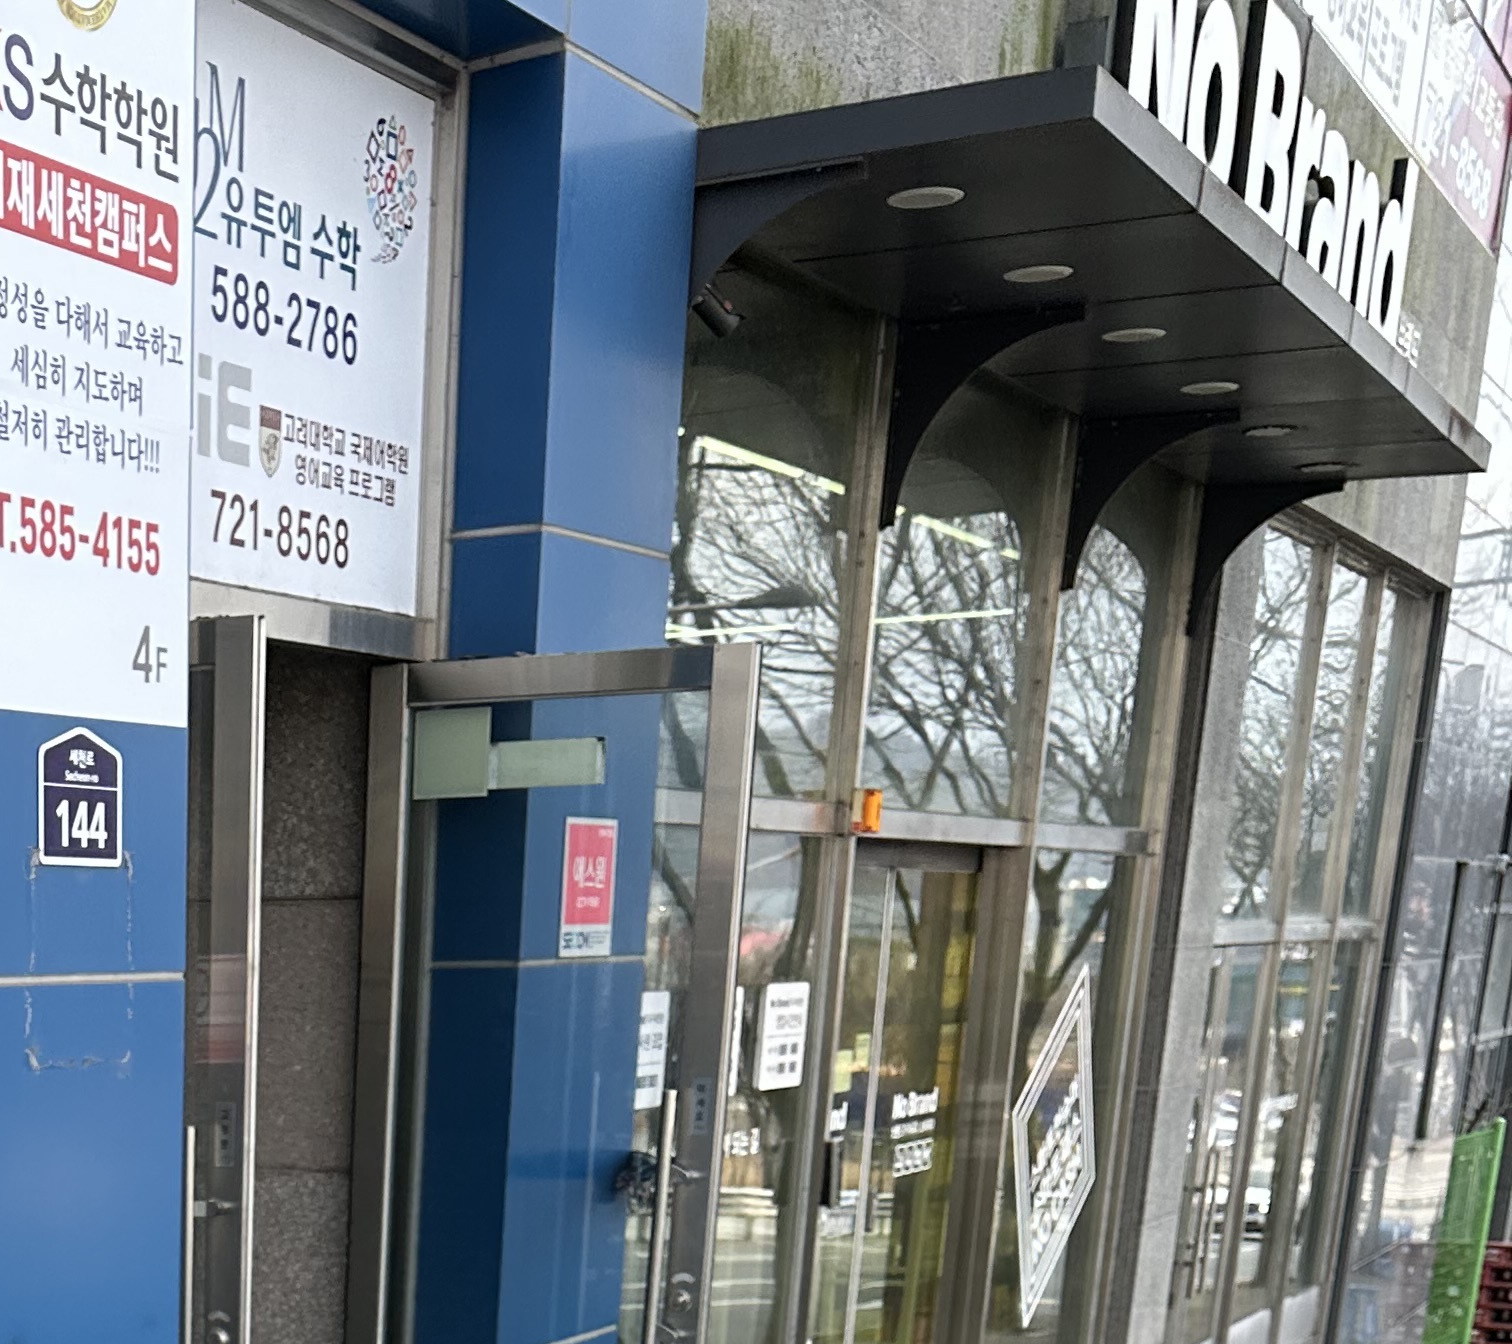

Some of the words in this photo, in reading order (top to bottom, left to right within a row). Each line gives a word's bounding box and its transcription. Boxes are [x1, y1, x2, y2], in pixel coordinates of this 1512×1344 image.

[1244, 0, 1419, 353] Brand
[221, 193, 302, 271] 유투엠
[312, 216, 361, 291] 수학
[56, 296, 110, 350] 다해서
[115, 318, 184, 368] 교육하고
[210, 265, 357, 366] 588-2786
[10, 346, 65, 397] 세심히
[73, 361, 144, 417] 지도하며
[54, 415, 160, 474] 관리합니다!!!
[210, 489, 350, 570] 721-8568
[131, 624, 169, 684] 4F
[56, 799, 108, 849] 144
